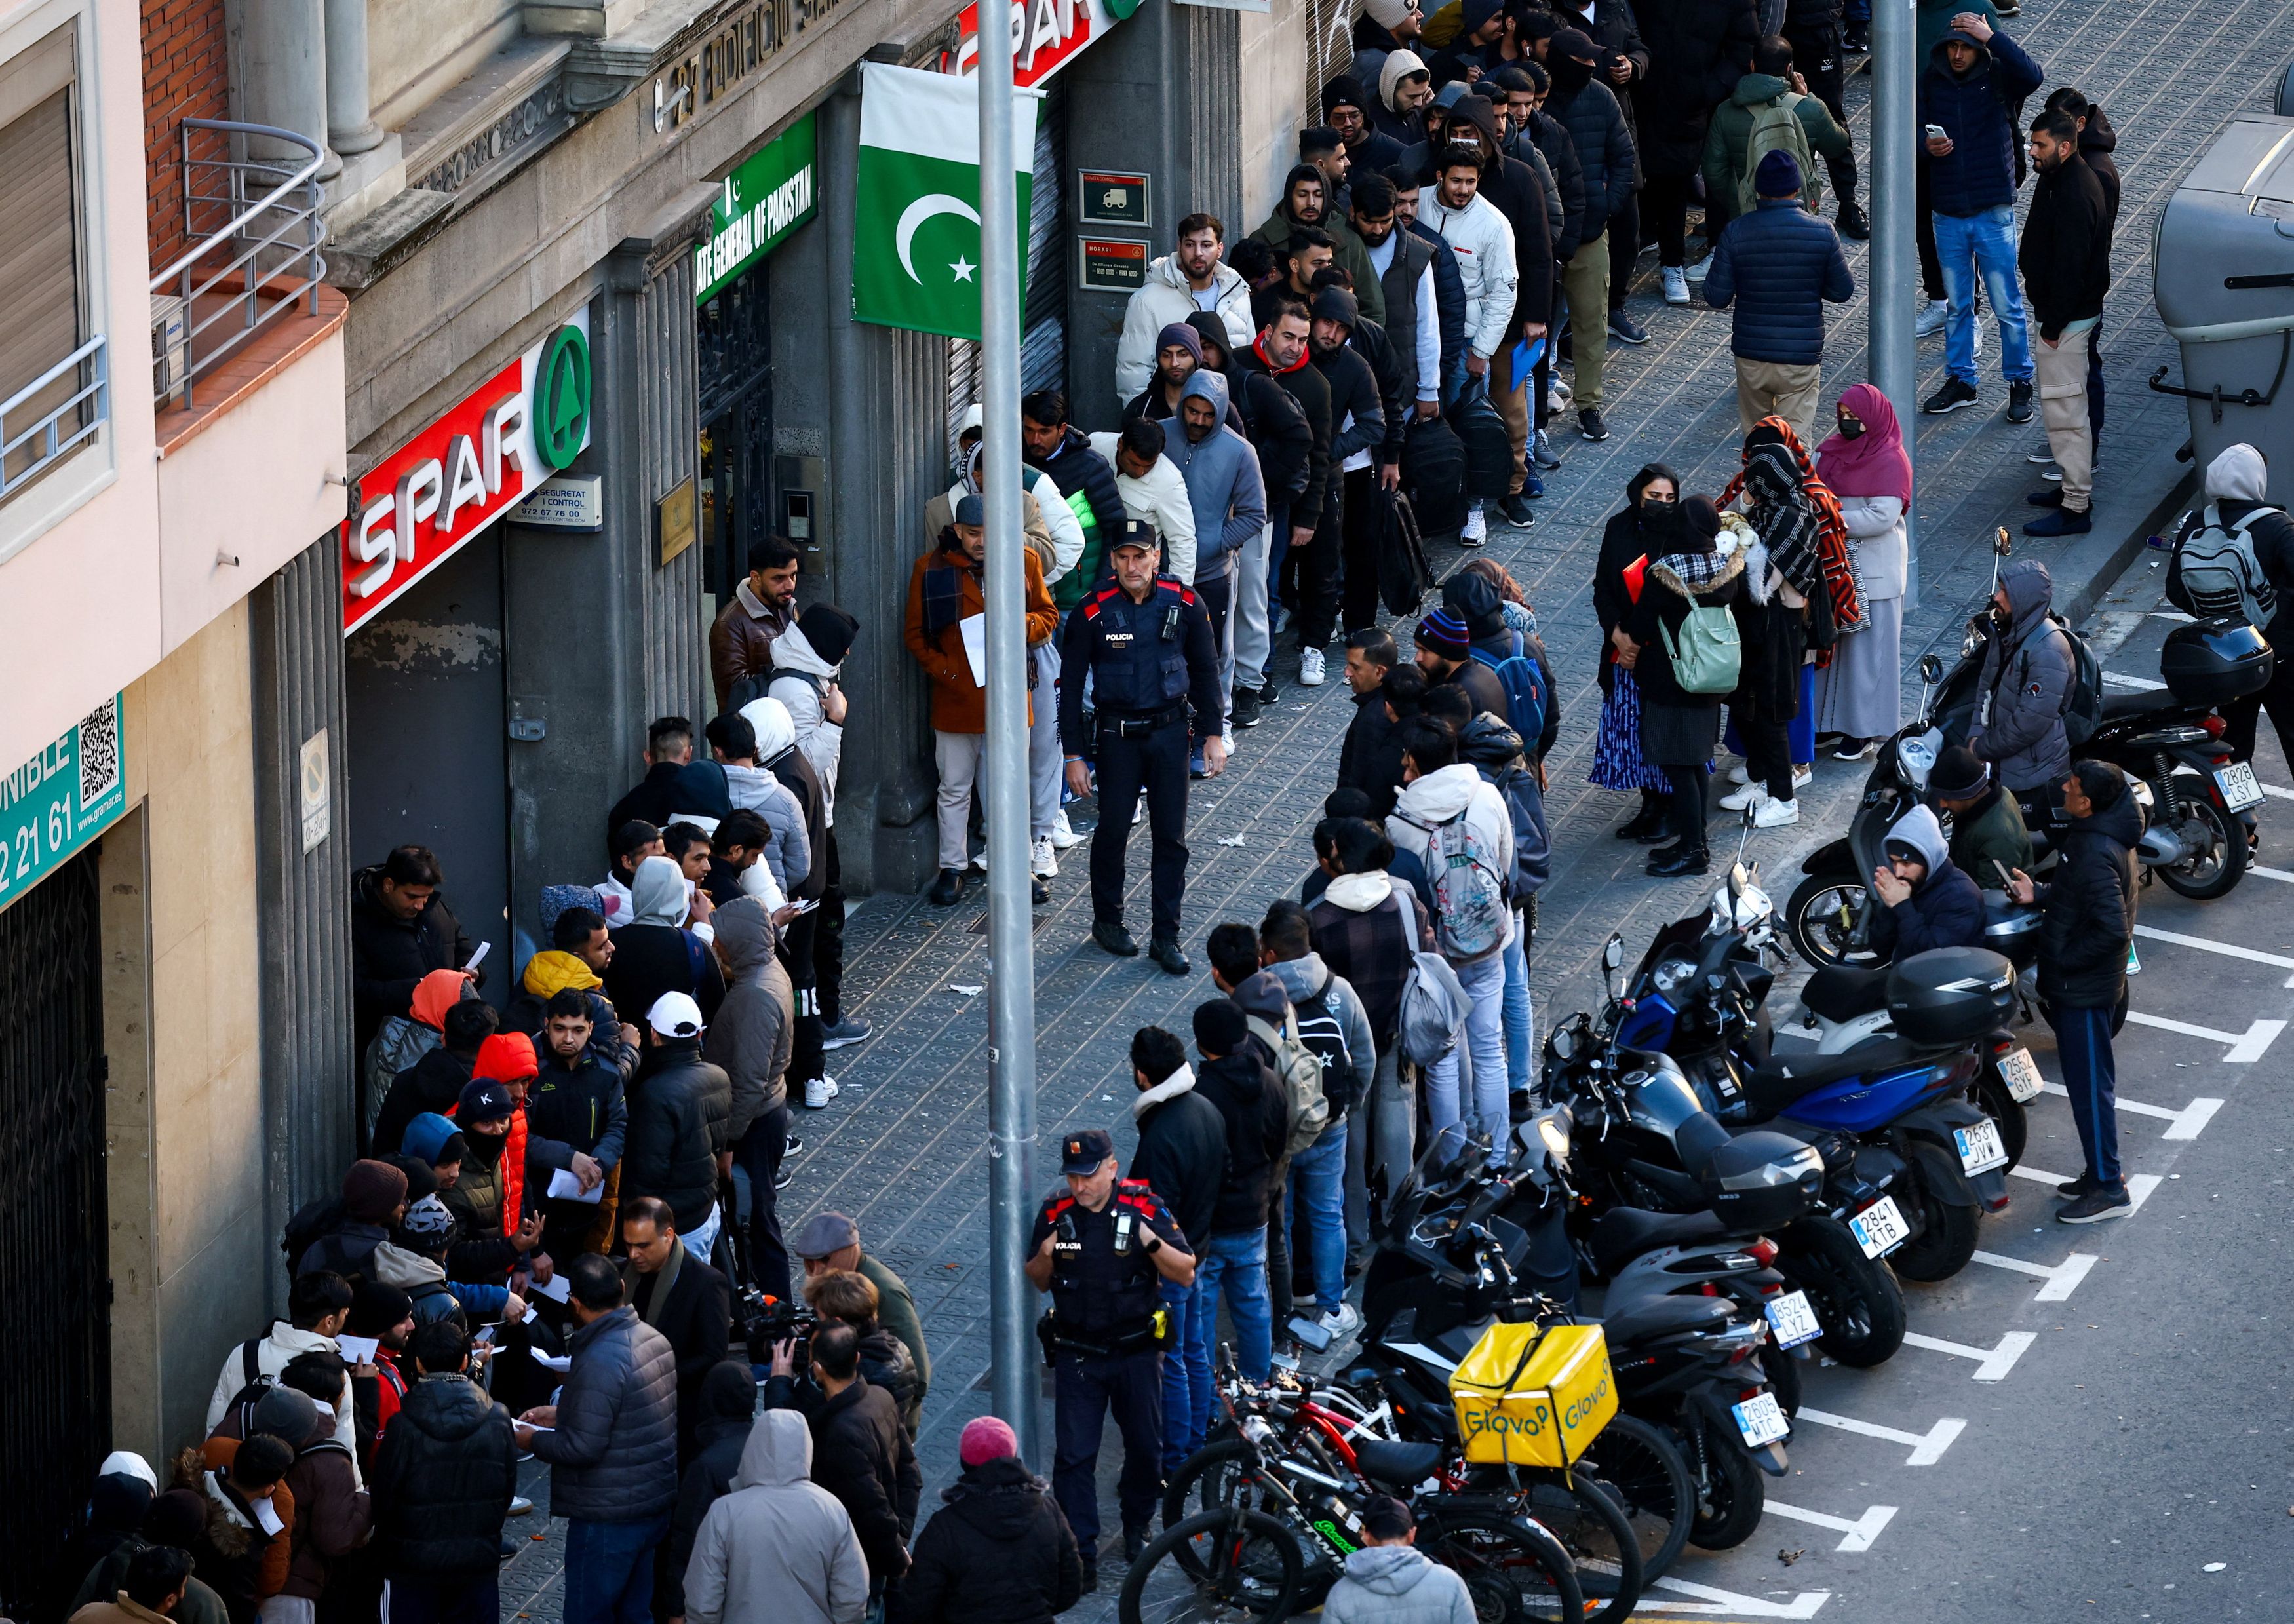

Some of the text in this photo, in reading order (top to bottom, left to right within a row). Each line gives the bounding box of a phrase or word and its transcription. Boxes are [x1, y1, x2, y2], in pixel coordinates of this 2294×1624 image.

[676, 55, 699, 125] 27
[714, 210, 752, 281] GENERAL
[754, 199, 766, 249] OF
[768, 163, 811, 240] PAKISTAN
[350, 392, 528, 598] SPAR
[540, 489, 586, 497] SEGURETAT
[2224, 765, 2252, 787] 2828
[2230, 781, 2252, 802] LSY
[77, 790, 123, 832] www.gramar.es
[16, 816, 39, 880] 21
[48, 791, 72, 853] 61
[1989, 979, 2010, 992] SHAD
[2006, 1053, 2032, 1077] 2552
[2014, 1072, 2032, 1093] GYP
[480, 1093, 492, 1105] K
[1966, 1123, 1994, 1146] 2637
[1973, 1142, 1995, 1163] JVW
[1861, 1202, 1894, 1233] 2841
[1869, 1223, 1897, 1249] KTB
[1774, 1296, 1806, 1319] 8524
[1782, 1315, 1808, 1337] LYZ
[1565, 1379, 1606, 1429] Glovo
[1744, 1397, 1777, 1422] 2605
[1466, 1408, 1540, 1436] Glovo
[1751, 1418, 1778, 1440] MTC
